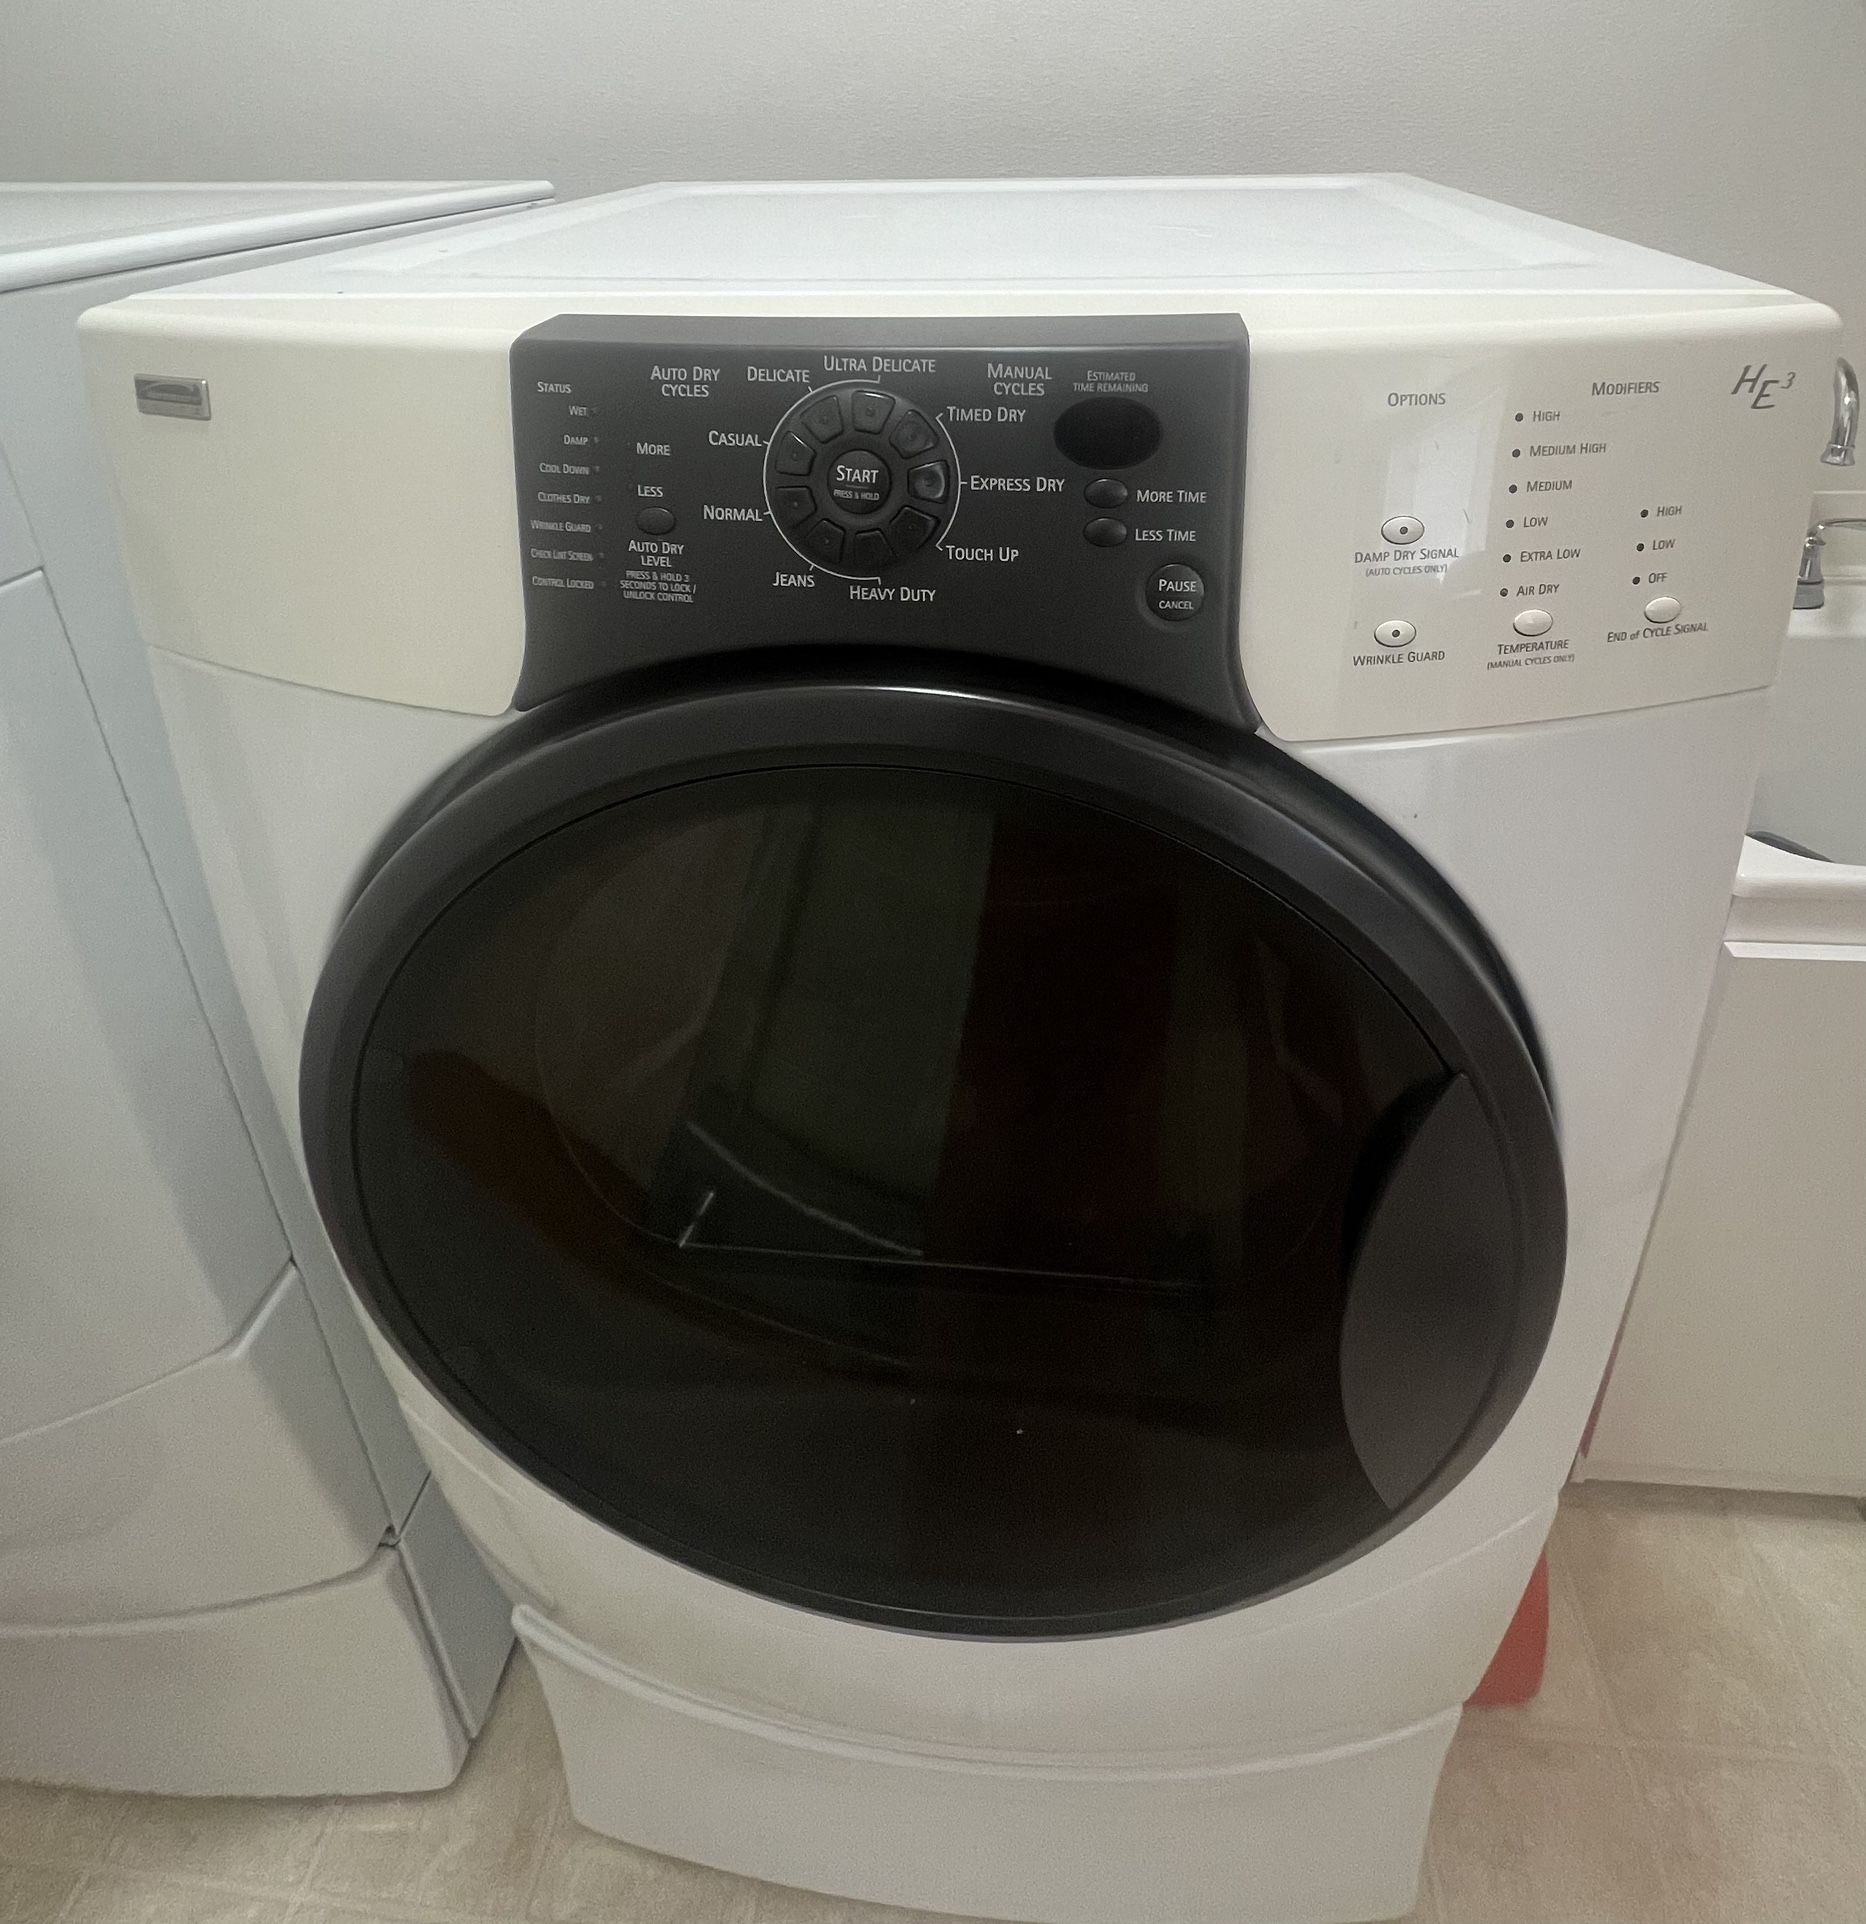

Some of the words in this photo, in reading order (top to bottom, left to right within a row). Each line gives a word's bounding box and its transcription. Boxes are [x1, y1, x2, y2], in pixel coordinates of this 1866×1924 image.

[823, 355, 867, 372] ULTRA
[872, 356, 936, 373] DELICATE
[651, 365, 687, 381] AUTO
[693, 366, 720, 382] DRY
[747, 366, 810, 383] DELICATE
[987, 363, 1052, 380] MANUAL
[1087, 370, 1136, 382] ESTIMATED
[537, 382, 571, 393] STATUS
[661, 384, 709, 398] CYCLES
[994, 382, 1045, 396] CYCLES
[1073, 383, 1095, 392] TIME
[1097, 383, 1148, 393] REMAINING
[1591, 380, 1660, 396] MODIFIERS
[1387, 392, 1446, 407] OPTIONS
[569, 406, 588, 417] WET
[947, 406, 992, 422] TIMED
[997, 407, 1026, 422] DRY
[1532, 409, 1560, 422] HIGH
[564, 435, 588, 445] DAMP
[708, 431, 762, 447] CASUAL
[636, 443, 671, 456] MORE
[1529, 443, 1576, 457] MEDIUM
[1579, 441, 1607, 454] HIGH
[539, 463, 561, 474] COOL
[563, 464, 589, 475] DOWN
[836, 465, 879, 484] START
[637, 484, 663, 498] LESS
[971, 476, 1031, 492] EXPRESS
[1037, 477, 1066, 493] DRY
[1526, 479, 1573, 493] MEDIUM
[538, 492, 571, 504] CLOTHES
[573, 493, 590, 504] DRY
[833, 489, 852, 499] PRESS
[861, 490, 879, 500] HOLD
[1136, 490, 1173, 502] MORE
[1177, 490, 1207, 503] TIME
[703, 505, 763, 522] NORMAL
[1656, 505, 1682, 517] HIGH
[565, 521, 591, 533] GUARD
[1523, 515, 1549, 528] LOW
[1135, 529, 1163, 541] LESS
[1166, 529, 1196, 542] TIME
[628, 540, 657, 553] AUTO
[662, 541, 684, 554] DRY
[1652, 538, 1676, 551] LOW
[946, 545, 994, 561] TOUCH
[999, 546, 1019, 562] UP
[1354, 550, 1391, 563] DAMP
[1393, 548, 1417, 562] DRY
[1419, 547, 1460, 561] SIGNAL
[1519, 550, 1553, 562] EXTRA
[1556, 547, 1581, 560] LOW
[641, 555, 672, 568] LEVEL
[626, 570, 650, 580] PRESS
[660, 571, 683, 582] HOLD
[684, 574, 690, 582] 3
[1365, 566, 1391, 577] (AUTO
[1392, 565, 1422, 575] CYCLES
[1423, 563, 1448, 575] ONLY)
[566, 578, 594, 589] LOCKED
[773, 572, 815, 587] JEANS
[1648, 572, 1668, 584] OFF
[620, 580, 656, 590] SECONDS
[658, 582, 669, 591] TO
[670, 582, 690, 593] LOCK
[1159, 579, 1197, 592] PAUSE
[1516, 585, 1535, 596] AIR
[1537, 582, 1560, 595] DRY
[623, 590, 655, 601] UNLOCK
[657, 592, 694, 603] CONTROL
[849, 584, 895, 601] HEAVY
[900, 587, 936, 602] DUTY
[1159, 601, 1194, 610] CANCEL
[1607, 630, 1628, 642] END
[1629, 628, 1640, 640] of
[1642, 625, 1672, 639] CYCLE
[1674, 621, 1709, 636] SIGNAL
[1497, 639, 1569, 655] TEMPERATURE
[1352, 651, 1405, 666] WRINKLE
[1407, 649, 1446, 663] GUARD
[1487, 657, 1522, 670] (MANUAL
[1525, 656, 1551, 667] CYCLES
[1553, 654, 1575, 665] ONLY)
